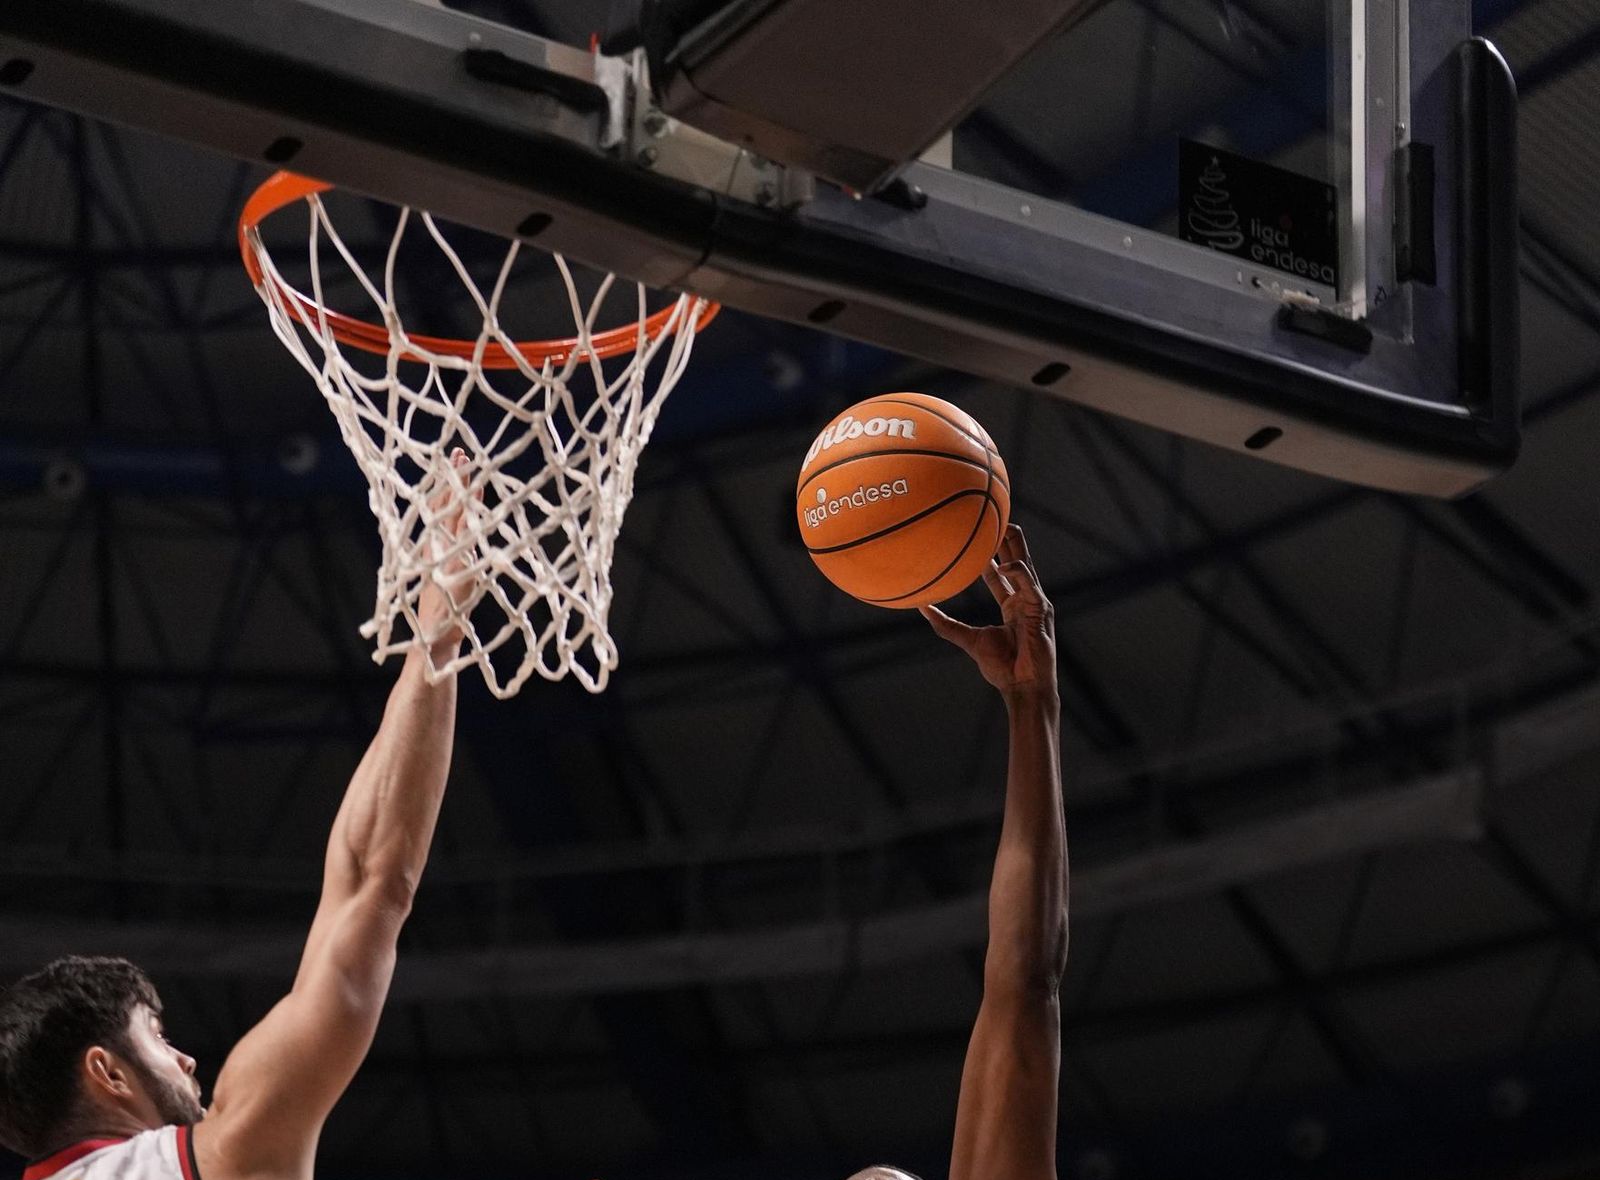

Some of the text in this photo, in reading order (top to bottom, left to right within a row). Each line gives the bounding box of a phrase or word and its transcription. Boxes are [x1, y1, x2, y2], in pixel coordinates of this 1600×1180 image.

[1250, 217, 1290, 248] liga
[1250, 243, 1336, 283] endesa
[804, 478, 909, 528] liga endesa
